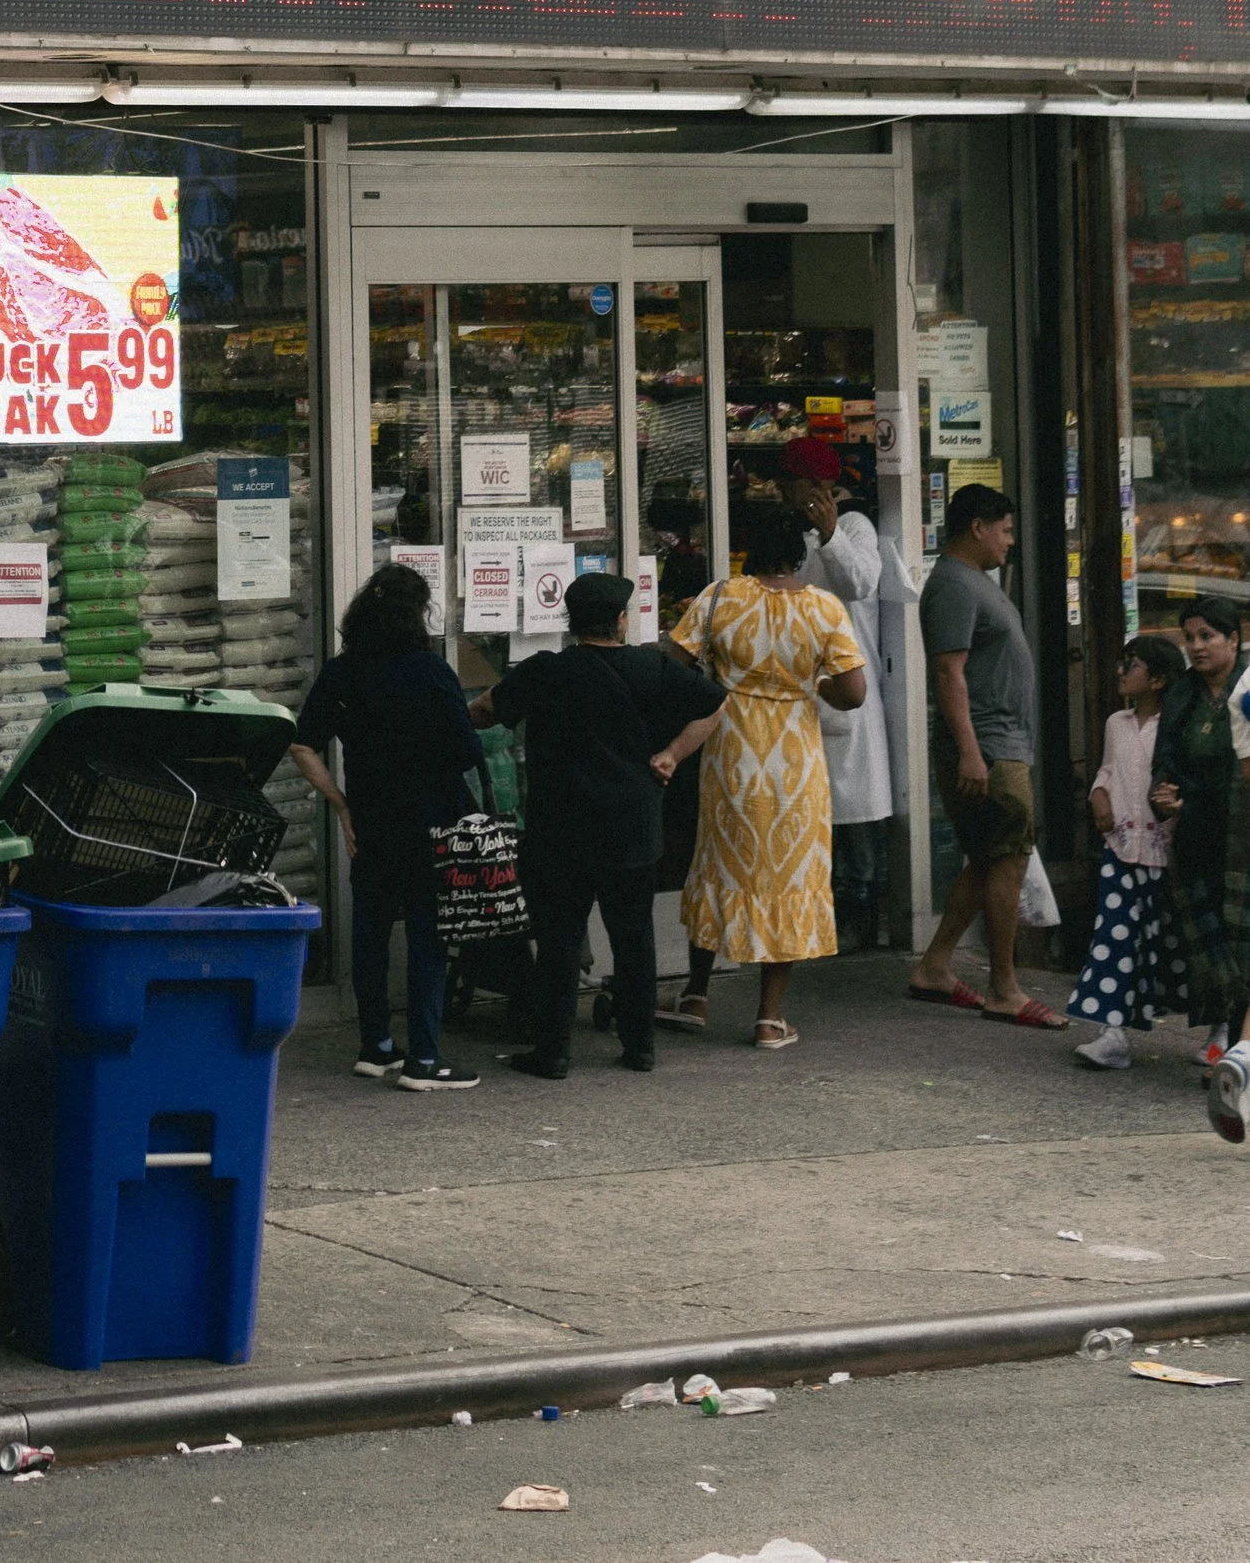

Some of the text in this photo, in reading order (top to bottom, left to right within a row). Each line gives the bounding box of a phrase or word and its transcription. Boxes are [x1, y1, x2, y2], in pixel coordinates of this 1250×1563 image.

[152, 410, 174, 434] LB
[939, 435, 981, 445] Sold Here
[480, 470, 510, 484] WIC
[231, 482, 275, 492] WE ACCEPT
[470, 516, 552, 527] WE RESERVE THE RIGHT
[464, 531, 473, 542] TO
[474, 531, 504, 542] INSPECT
[505, 531, 518, 541] ALL
[474, 571, 509, 583] CLOSED
[473, 588, 509, 597] CERRADO
[448, 835, 473, 852] New
[474, 831, 506, 857] York
[445, 866, 477, 886] New
